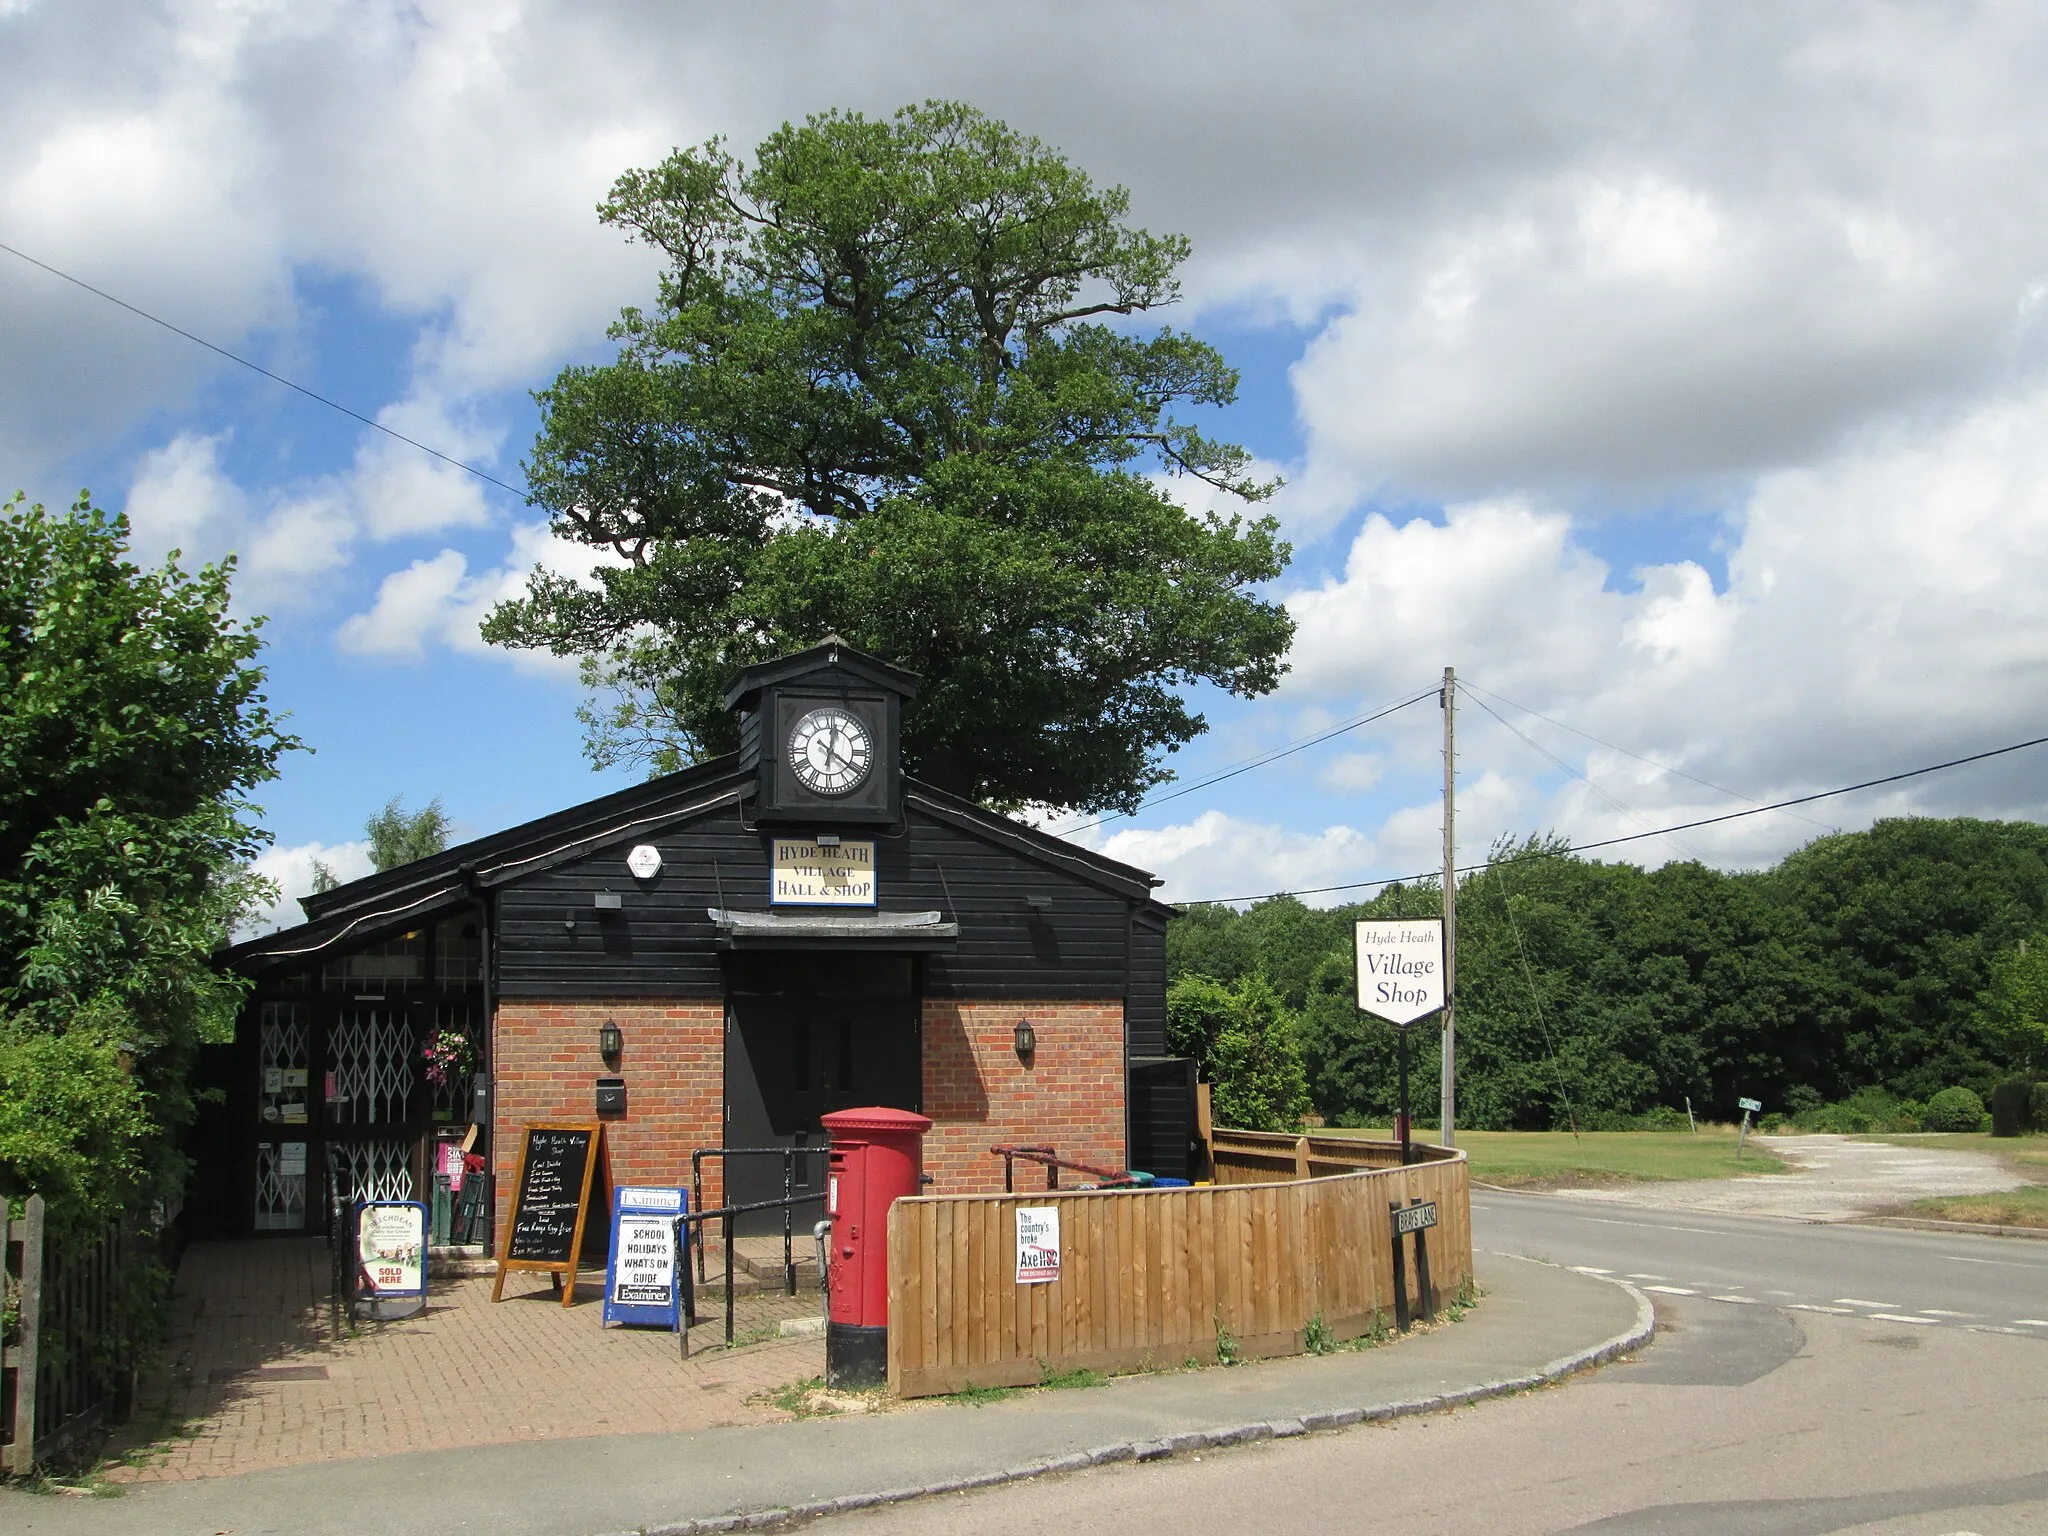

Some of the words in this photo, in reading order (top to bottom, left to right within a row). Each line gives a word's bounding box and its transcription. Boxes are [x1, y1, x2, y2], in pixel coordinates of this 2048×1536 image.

[780, 846, 817, 862] HYDE
[822, 847, 868, 863] HEATH
[794, 866, 856, 878] VILLAGE
[778, 880, 816, 896] HALL
[820, 886, 830, 896] &
[834, 882, 870, 896] SHOP
[1366, 932, 1396, 946] Hyde
[1400, 931, 1434, 943] Heath
[1367, 954, 1434, 978] Village
[1376, 982, 1428, 1006] Shop
[624, 1193, 678, 1206] Examiner
[368, 1215, 413, 1228] BEECHDEAN
[1020, 1212, 1031, 1224] The
[1400, 1210, 1418, 1230] BRAYS
[1421, 1206, 1435, 1224] LANE
[634, 1230, 664, 1239] SCHOOL
[1021, 1222, 1050, 1235] country's
[1021, 1234, 1037, 1244] broke
[628, 1244, 667, 1254] HOLIDAYS
[624, 1258, 655, 1269] WHAT'S
[657, 1260, 668, 1269] ON
[1020, 1251, 1038, 1267] Axe
[634, 1273, 657, 1283] GUIDE
[622, 1289, 666, 1300] Examiner
